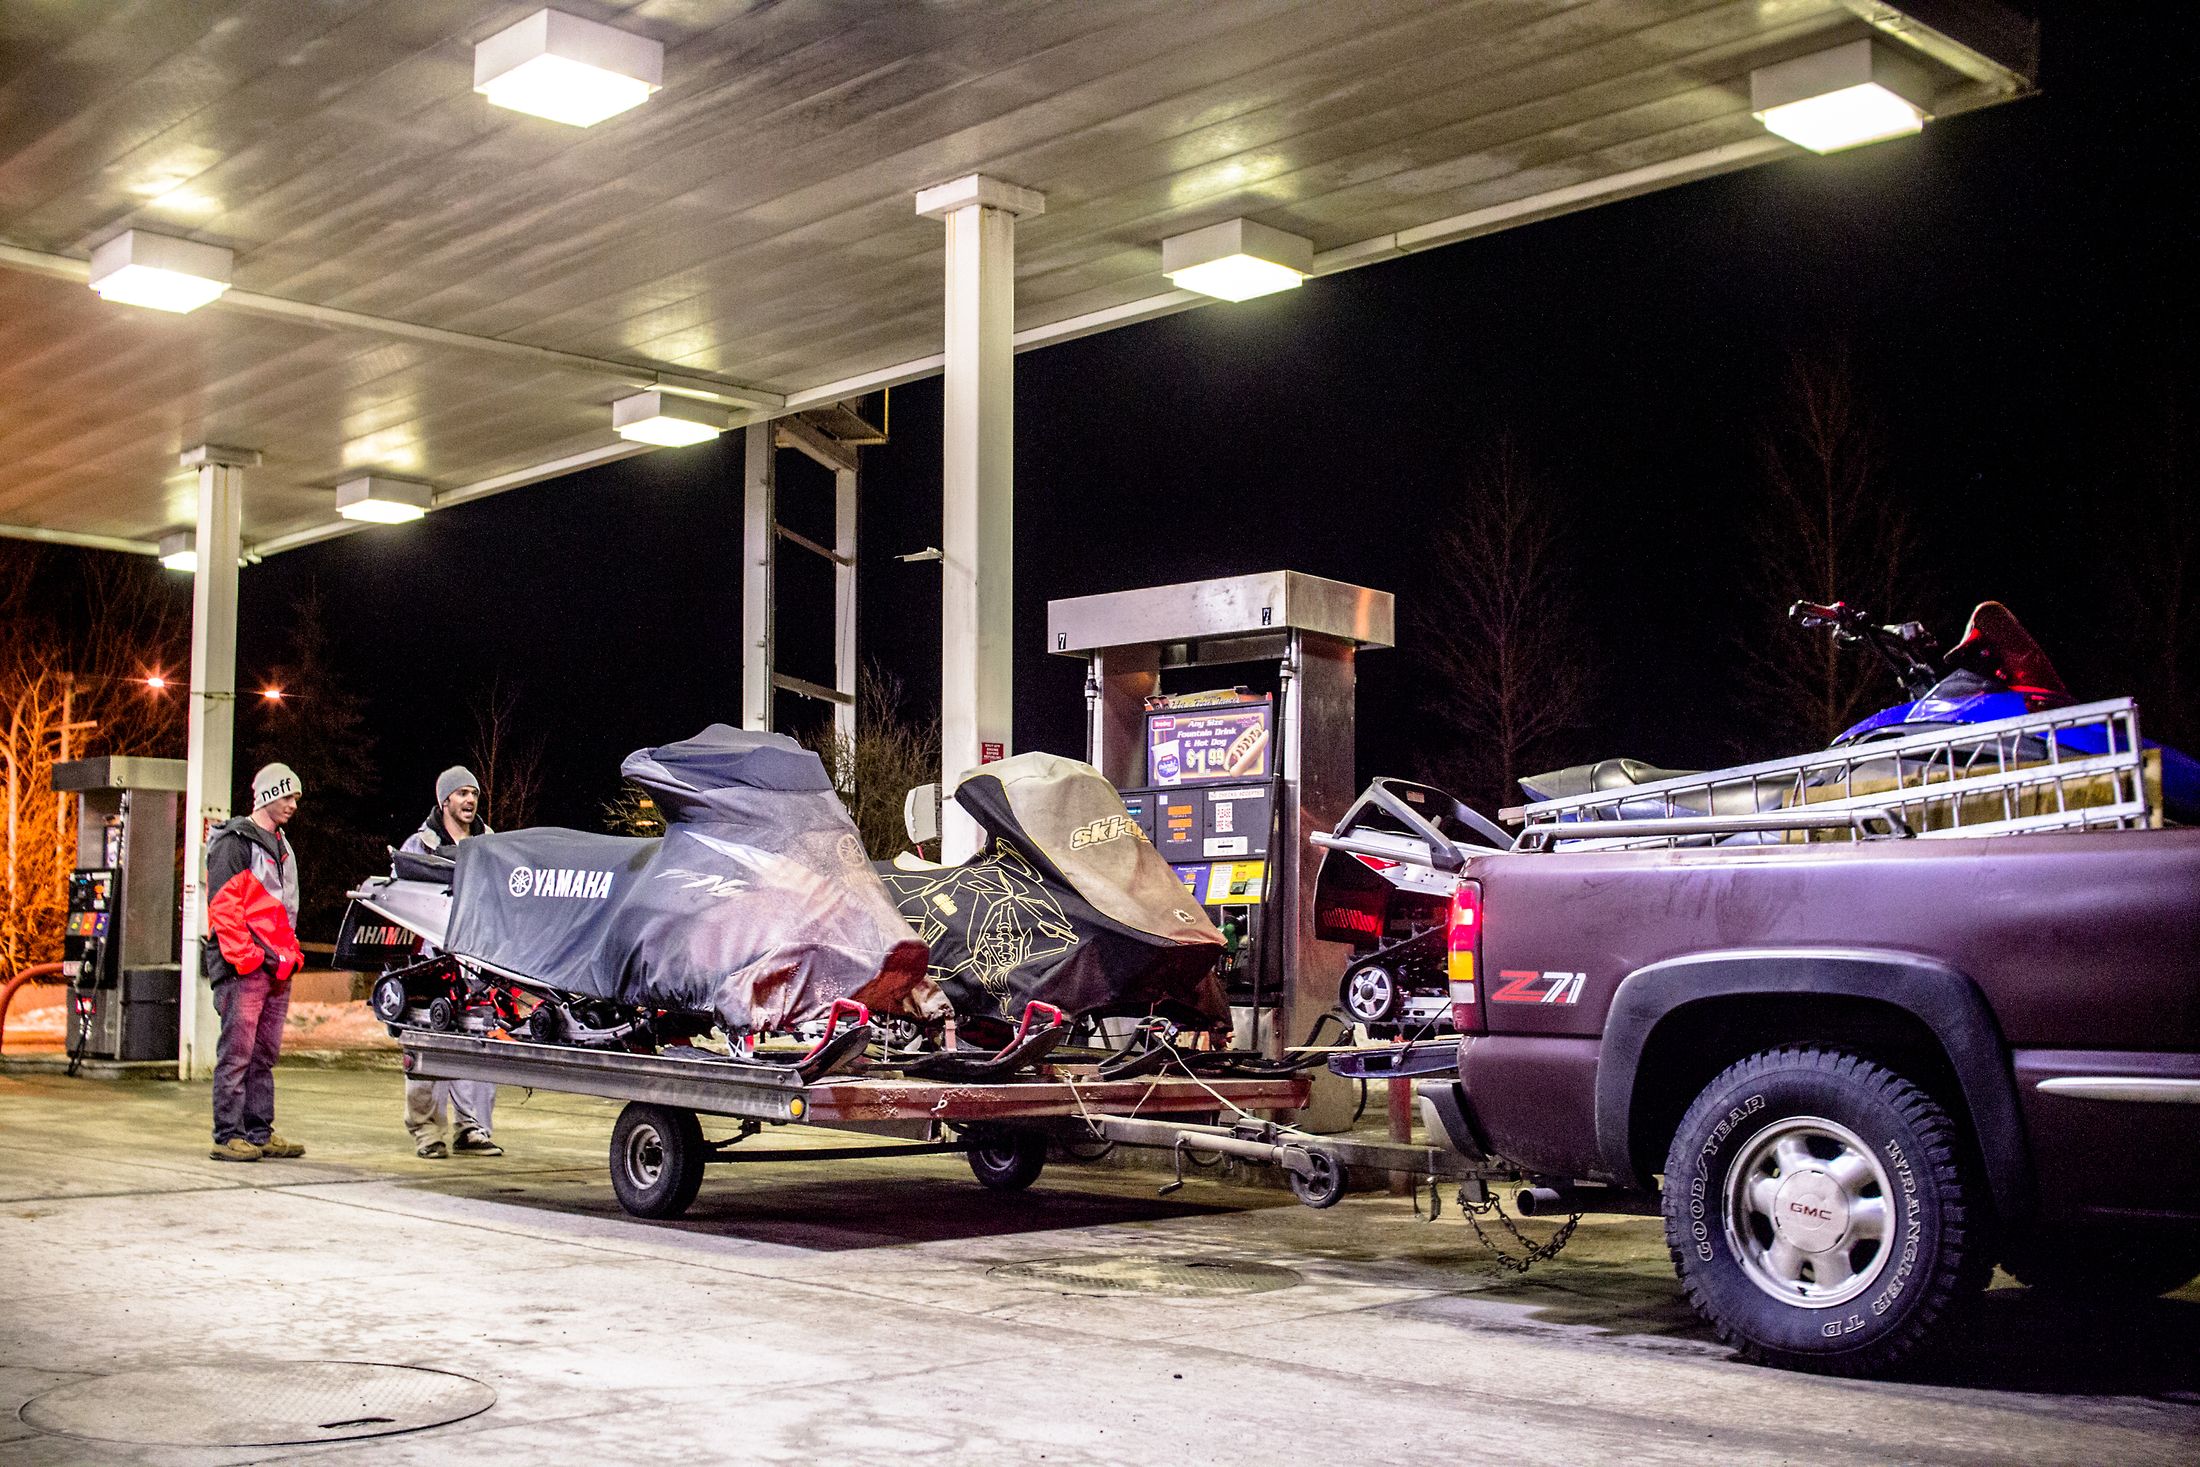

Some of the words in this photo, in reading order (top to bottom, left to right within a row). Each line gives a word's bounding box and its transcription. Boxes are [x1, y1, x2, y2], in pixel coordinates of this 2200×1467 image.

[1058, 633, 1067, 650] 7
[1177, 729, 1213, 739] Fountain
[1214, 727, 1237, 736] Drink
[1187, 720, 1205, 729] Any
[1206, 718, 1224, 727] Size
[1193, 739, 1209, 748] Hot
[1210, 738, 1227, 748] Dog
[261, 777, 291, 802] neff
[533, 868, 615, 899] YAMAHA
[1491, 969, 1587, 1004] Z71
[1689, 1094, 1766, 1262] GOODYEAR
[1790, 1202, 1834, 1221] GMC
[1872, 1139, 1921, 1316] WRANGLER
[1822, 1314, 1867, 1337] TD
